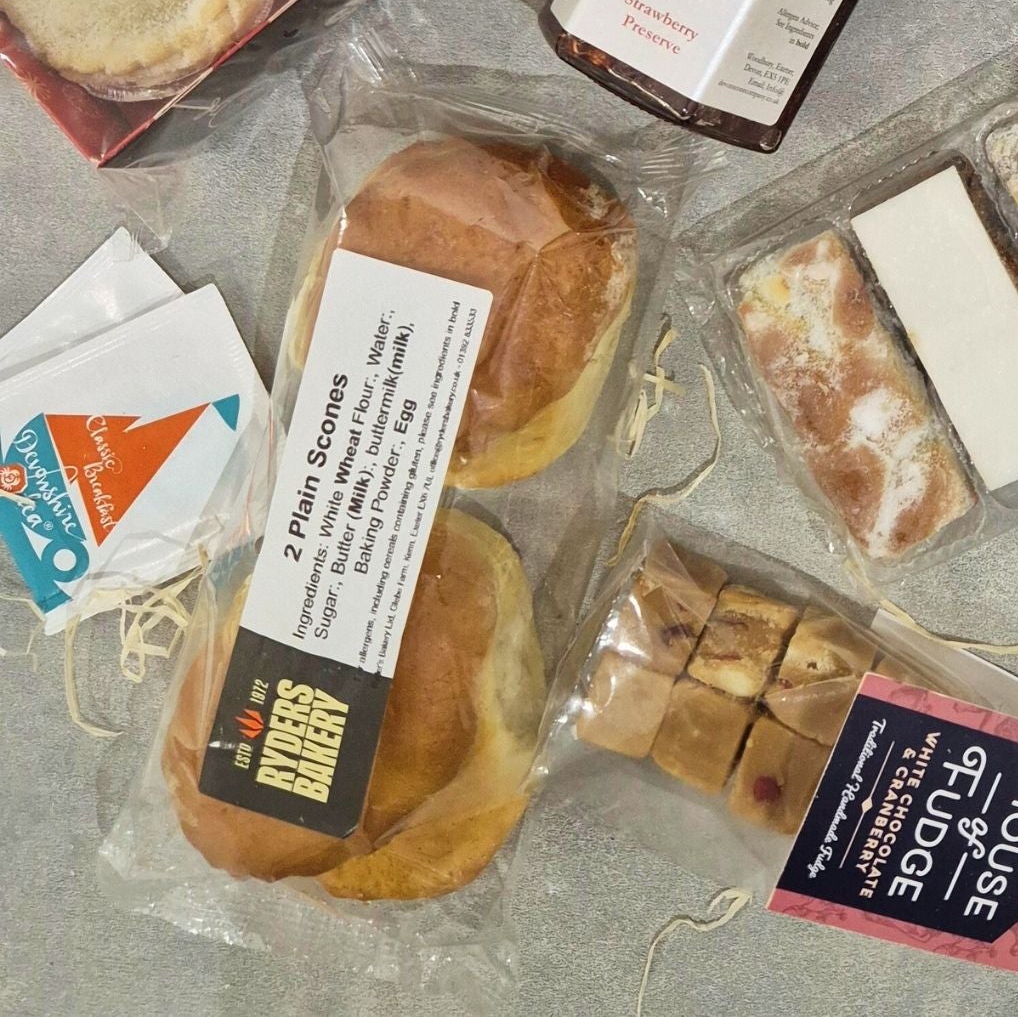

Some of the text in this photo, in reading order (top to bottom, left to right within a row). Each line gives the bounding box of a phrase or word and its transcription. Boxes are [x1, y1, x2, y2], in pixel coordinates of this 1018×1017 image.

[622, 14, 680, 54] Preserve
[447, 325, 454, 334] in
[448, 301, 461, 323] bold
[432, 337, 451, 389] ingredients
[417, 411, 432, 444] please
[427, 391, 437, 409] see
[84, 416, 124, 475] Classic
[284, 374, 348, 562] 2 Plain Scones
[13, 430, 85, 539] Devonshire
[82, 461, 120, 533] Breakfast
[354, 517, 384, 574] Baking
[393, 399, 417, 434] Egg
[393, 481, 414, 532] containing
[292, 544, 328, 639] Ingredients:
[319, 491, 343, 537] White
[334, 429, 362, 484] Wheat
[330, 523, 355, 575] Butter
[383, 534, 398, 569] cereals
[371, 571, 389, 614] including
[231, 676, 271, 770] ESTD 1972
[254, 678, 316, 791] RYDERS
[291, 687, 350, 803] BAKERY
[807, 718, 887, 878] Traditional Handmade Fudge
[856, 748, 916, 873] & CRANBERRY
[859, 732, 941, 898] WHITE CHOCOLATE
[887, 746, 987, 902] FUDGE
[957, 817, 988, 859] of
